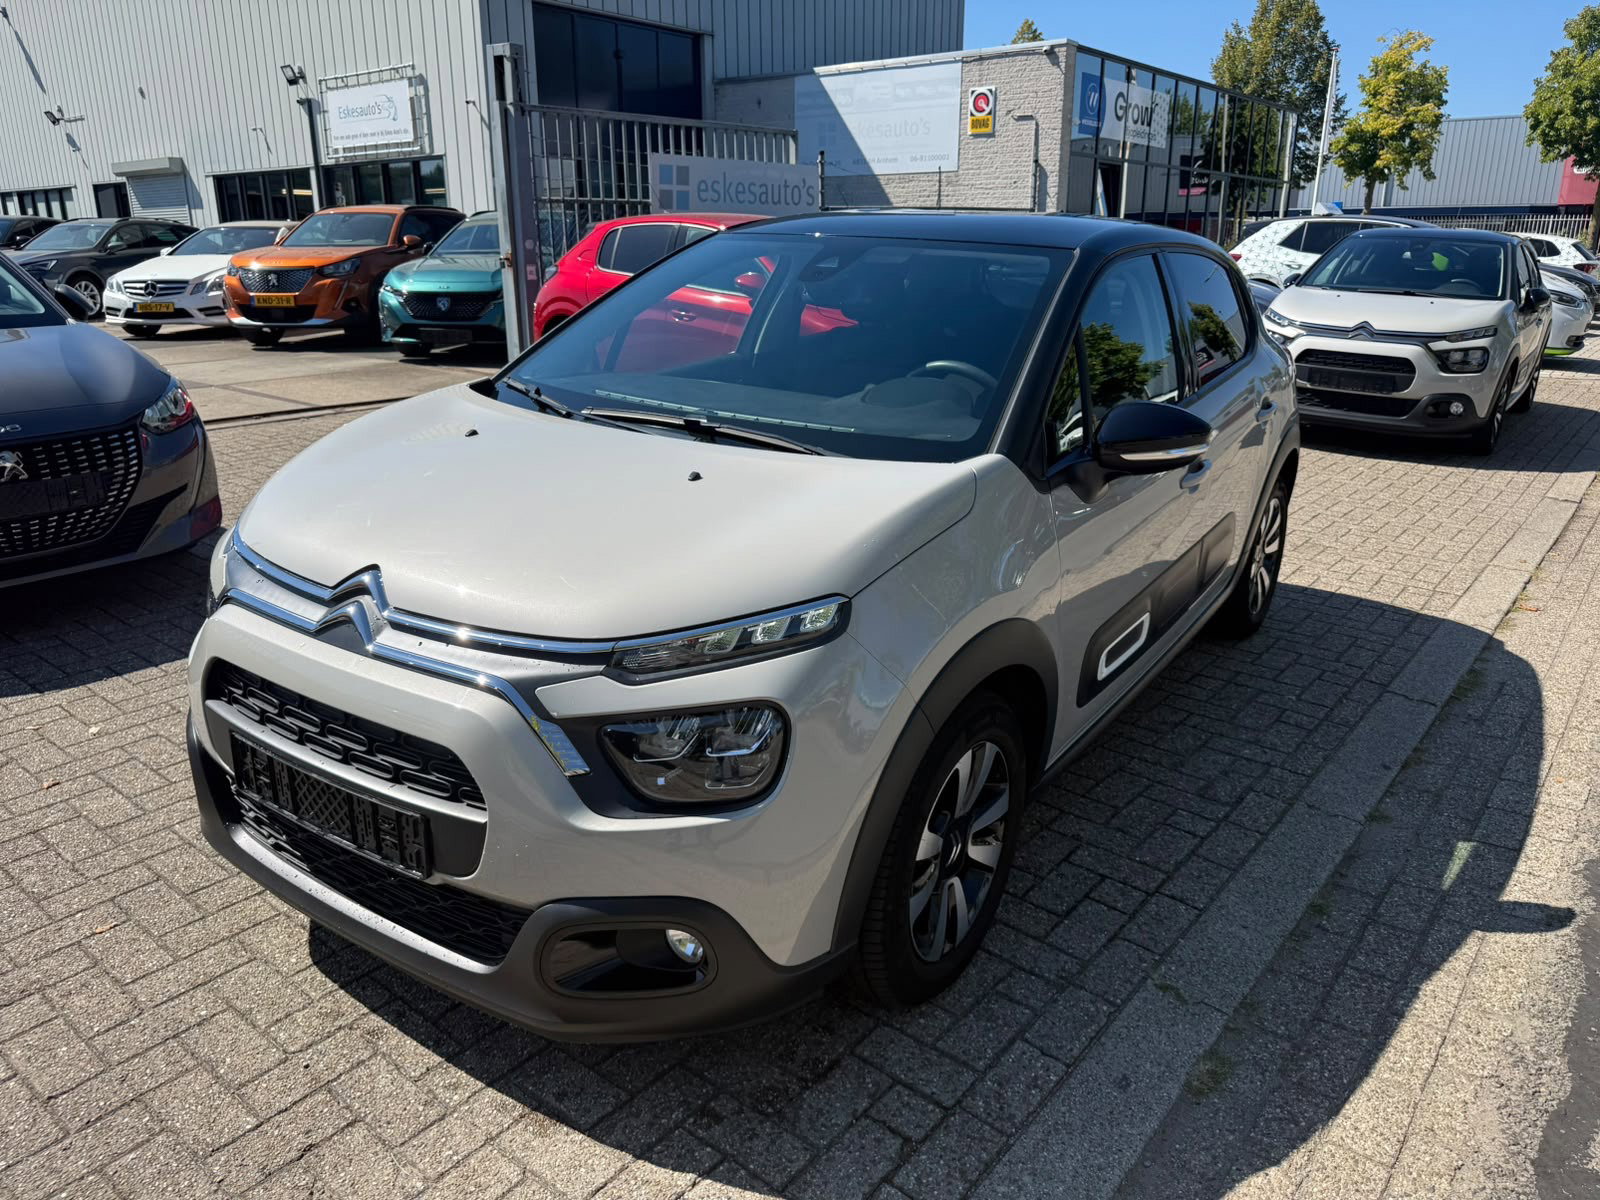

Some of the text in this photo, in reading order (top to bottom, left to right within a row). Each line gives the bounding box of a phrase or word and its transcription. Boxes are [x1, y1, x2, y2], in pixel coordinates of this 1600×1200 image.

[338, 101, 382, 119] Eskesauto's
[971, 117, 990, 130] BOVAG
[697, 171, 815, 207] eskesauto's
